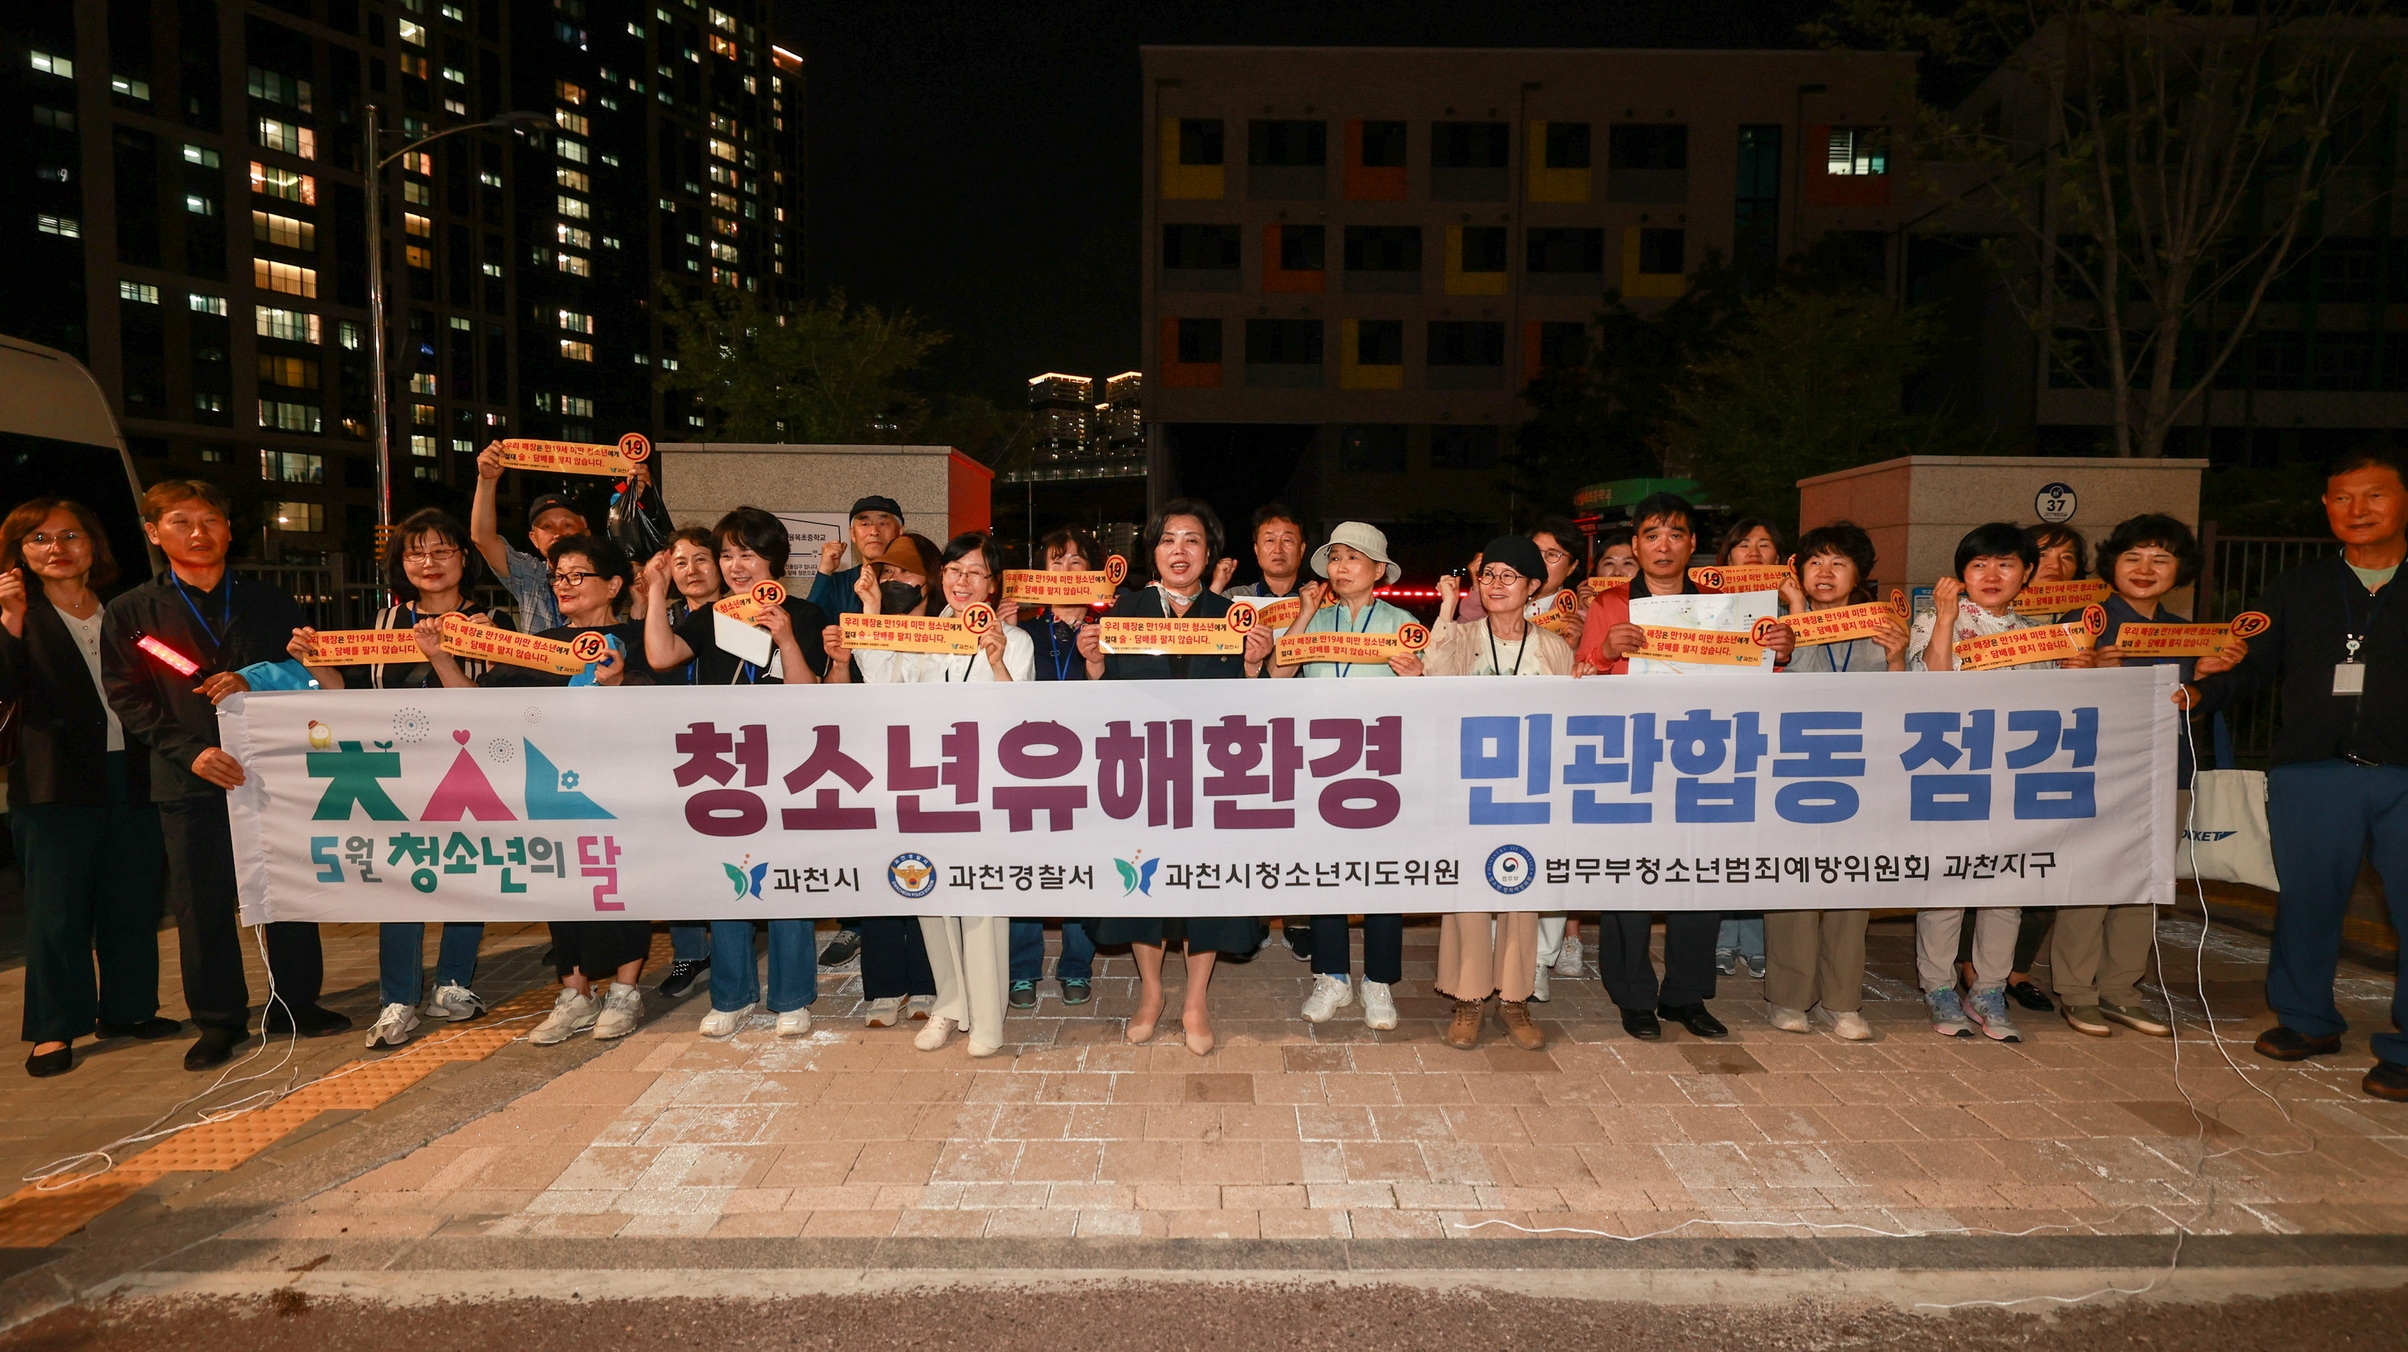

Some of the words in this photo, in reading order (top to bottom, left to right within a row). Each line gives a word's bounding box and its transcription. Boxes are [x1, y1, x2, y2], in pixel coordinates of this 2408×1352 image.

[504, 442, 520, 451] 우리
[522, 443, 543, 452] 매장은
[544, 444, 568, 454] 만19세
[570, 446, 585, 455] 미만
[586, 447, 620, 458] 청소년에게
[625, 439, 643, 455] 19
[518, 453, 525, 462] 술
[533, 453, 555, 463] 담배를
[558, 455, 572, 464] 팔지
[574, 456, 605, 467] 않습니다.
[2046, 500, 2066, 512] 37
[1109, 562, 1122, 578] 19
[1725, 575, 1747, 584] 만19세
[1748, 573, 1762, 581] 미만
[1763, 572, 1791, 580] 청소년에게
[1005, 573, 1017, 581] 우리
[1016, 574, 1034, 582] 매장은
[1035, 574, 1058, 584] 만19세
[1060, 575, 1073, 584] 미만
[1075, 575, 1106, 584] 청소년에게
[1703, 572, 1720, 586] 19
[757, 587, 778, 600] 19
[1025, 585, 1044, 595] 담배를
[1046, 586, 1061, 595] 팔지
[1063, 586, 1092, 596] 않습니다.
[720, 598, 751, 613] 청소년에게
[1269, 602, 1287, 614] 만19세
[1287, 600, 1300, 609] 미만
[1559, 595, 1573, 610] 19
[1894, 596, 1907, 612] 19
[968, 609, 988, 628] 19
[1234, 609, 1253, 627] 19
[1277, 612, 1291, 621] 팔지
[1802, 615, 1824, 625] 매장은
[1824, 610, 1849, 622] 만19세
[1851, 607, 1867, 617] 미만
[2087, 611, 2101, 629] 19
[844, 617, 859, 626] 우리
[861, 618, 883, 628] 매장은
[884, 619, 908, 629] 만19세
[910, 620, 926, 630] 미만
[927, 620, 962, 632] 청소년에게
[1104, 622, 1120, 631] 우리
[1122, 622, 1145, 631] 매장은
[1146, 622, 1172, 632] 만19세
[1174, 622, 1190, 632] 미만
[1191, 622, 1227, 632] 청소년에게
[1802, 628, 1810, 637] 술
[1816, 624, 1840, 635] 담배를
[1841, 621, 1858, 630] 팔지
[2237, 617, 2261, 632] 19
[321, 635, 344, 644] 매장은
[346, 634, 374, 643] 만19세
[377, 634, 394, 643] 미만
[444, 621, 458, 633] 우리
[460, 625, 484, 638] 매장은
[485, 631, 513, 644] 만19세
[514, 636, 531, 648] 미만
[532, 639, 570, 656] 청소년에게
[844, 631, 856, 639] 절대
[872, 631, 895, 641] 담배를
[897, 632, 912, 642] 팔지
[914, 633, 946, 644] 않습니다.
[1104, 635, 1117, 644] 절대
[1119, 635, 1127, 644] 술
[1135, 635, 1157, 644] 담배를
[1160, 635, 1176, 644] 팔지
[1178, 635, 1211, 645] 않습니다.
[1280, 639, 1295, 647] 우리
[1297, 637, 1318, 645] 매장은
[1319, 635, 1344, 644] 만19세
[1346, 636, 1361, 645] 미만
[1363, 636, 1398, 647] 청소년에게
[1404, 627, 1423, 643] 19
[1647, 629, 1668, 639] 매장은
[1670, 631, 1696, 642] 만19세
[1698, 634, 1714, 644] 미만
[1716, 635, 1749, 645] 청소년에게
[1955, 643, 1972, 654] 우리
[1973, 639, 1998, 649] 매장은
[1999, 633, 2028, 645] 만19세
[2030, 630, 2047, 640] 미만
[2049, 626, 2085, 637] 청소년에게
[320, 647, 327, 657] 술
[335, 646, 359, 656] 담배를
[361, 646, 379, 655] 팔지
[381, 645, 419, 654] 않습니다.
[443, 635, 453, 644] 절대
[455, 636, 463, 646] 술
[470, 639, 495, 653] 담배를
[497, 645, 513, 657] 팔지
[515, 648, 550, 664] 않습니다.
[580, 638, 600, 655] 19
[1294, 648, 1302, 656] 술
[1308, 645, 1330, 654] 담배를
[1333, 646, 1348, 655] 팔지
[1350, 647, 1382, 658] 않습니다.
[1657, 642, 1680, 653] 담배를
[1682, 644, 1698, 655] 팔지
[1700, 645, 1731, 656] 않습니다.
[1973, 654, 1982, 662] 술
[1990, 647, 2016, 659] 담배를
[2018, 644, 2036, 654] 팔지
[2038, 640, 2070, 652] 않습니다.
[673, 715, 1401, 837] 청소년유해환경
[1461, 710, 1865, 824] 민관합동
[1900, 707, 2098, 821] 점검
[310, 835, 383, 884] 5월
[387, 832, 565, 893] 청소년의
[578, 836, 625, 911] 달
[1166, 860, 1458, 889] 과천시청소년지도위원
[1547, 855, 1929, 884] 법무부청소년범죄예방위원회
[1943, 852, 2056, 879] 과천지구
[773, 866, 859, 893] 과천시
[950, 865, 1092, 891] 과천경찰서
